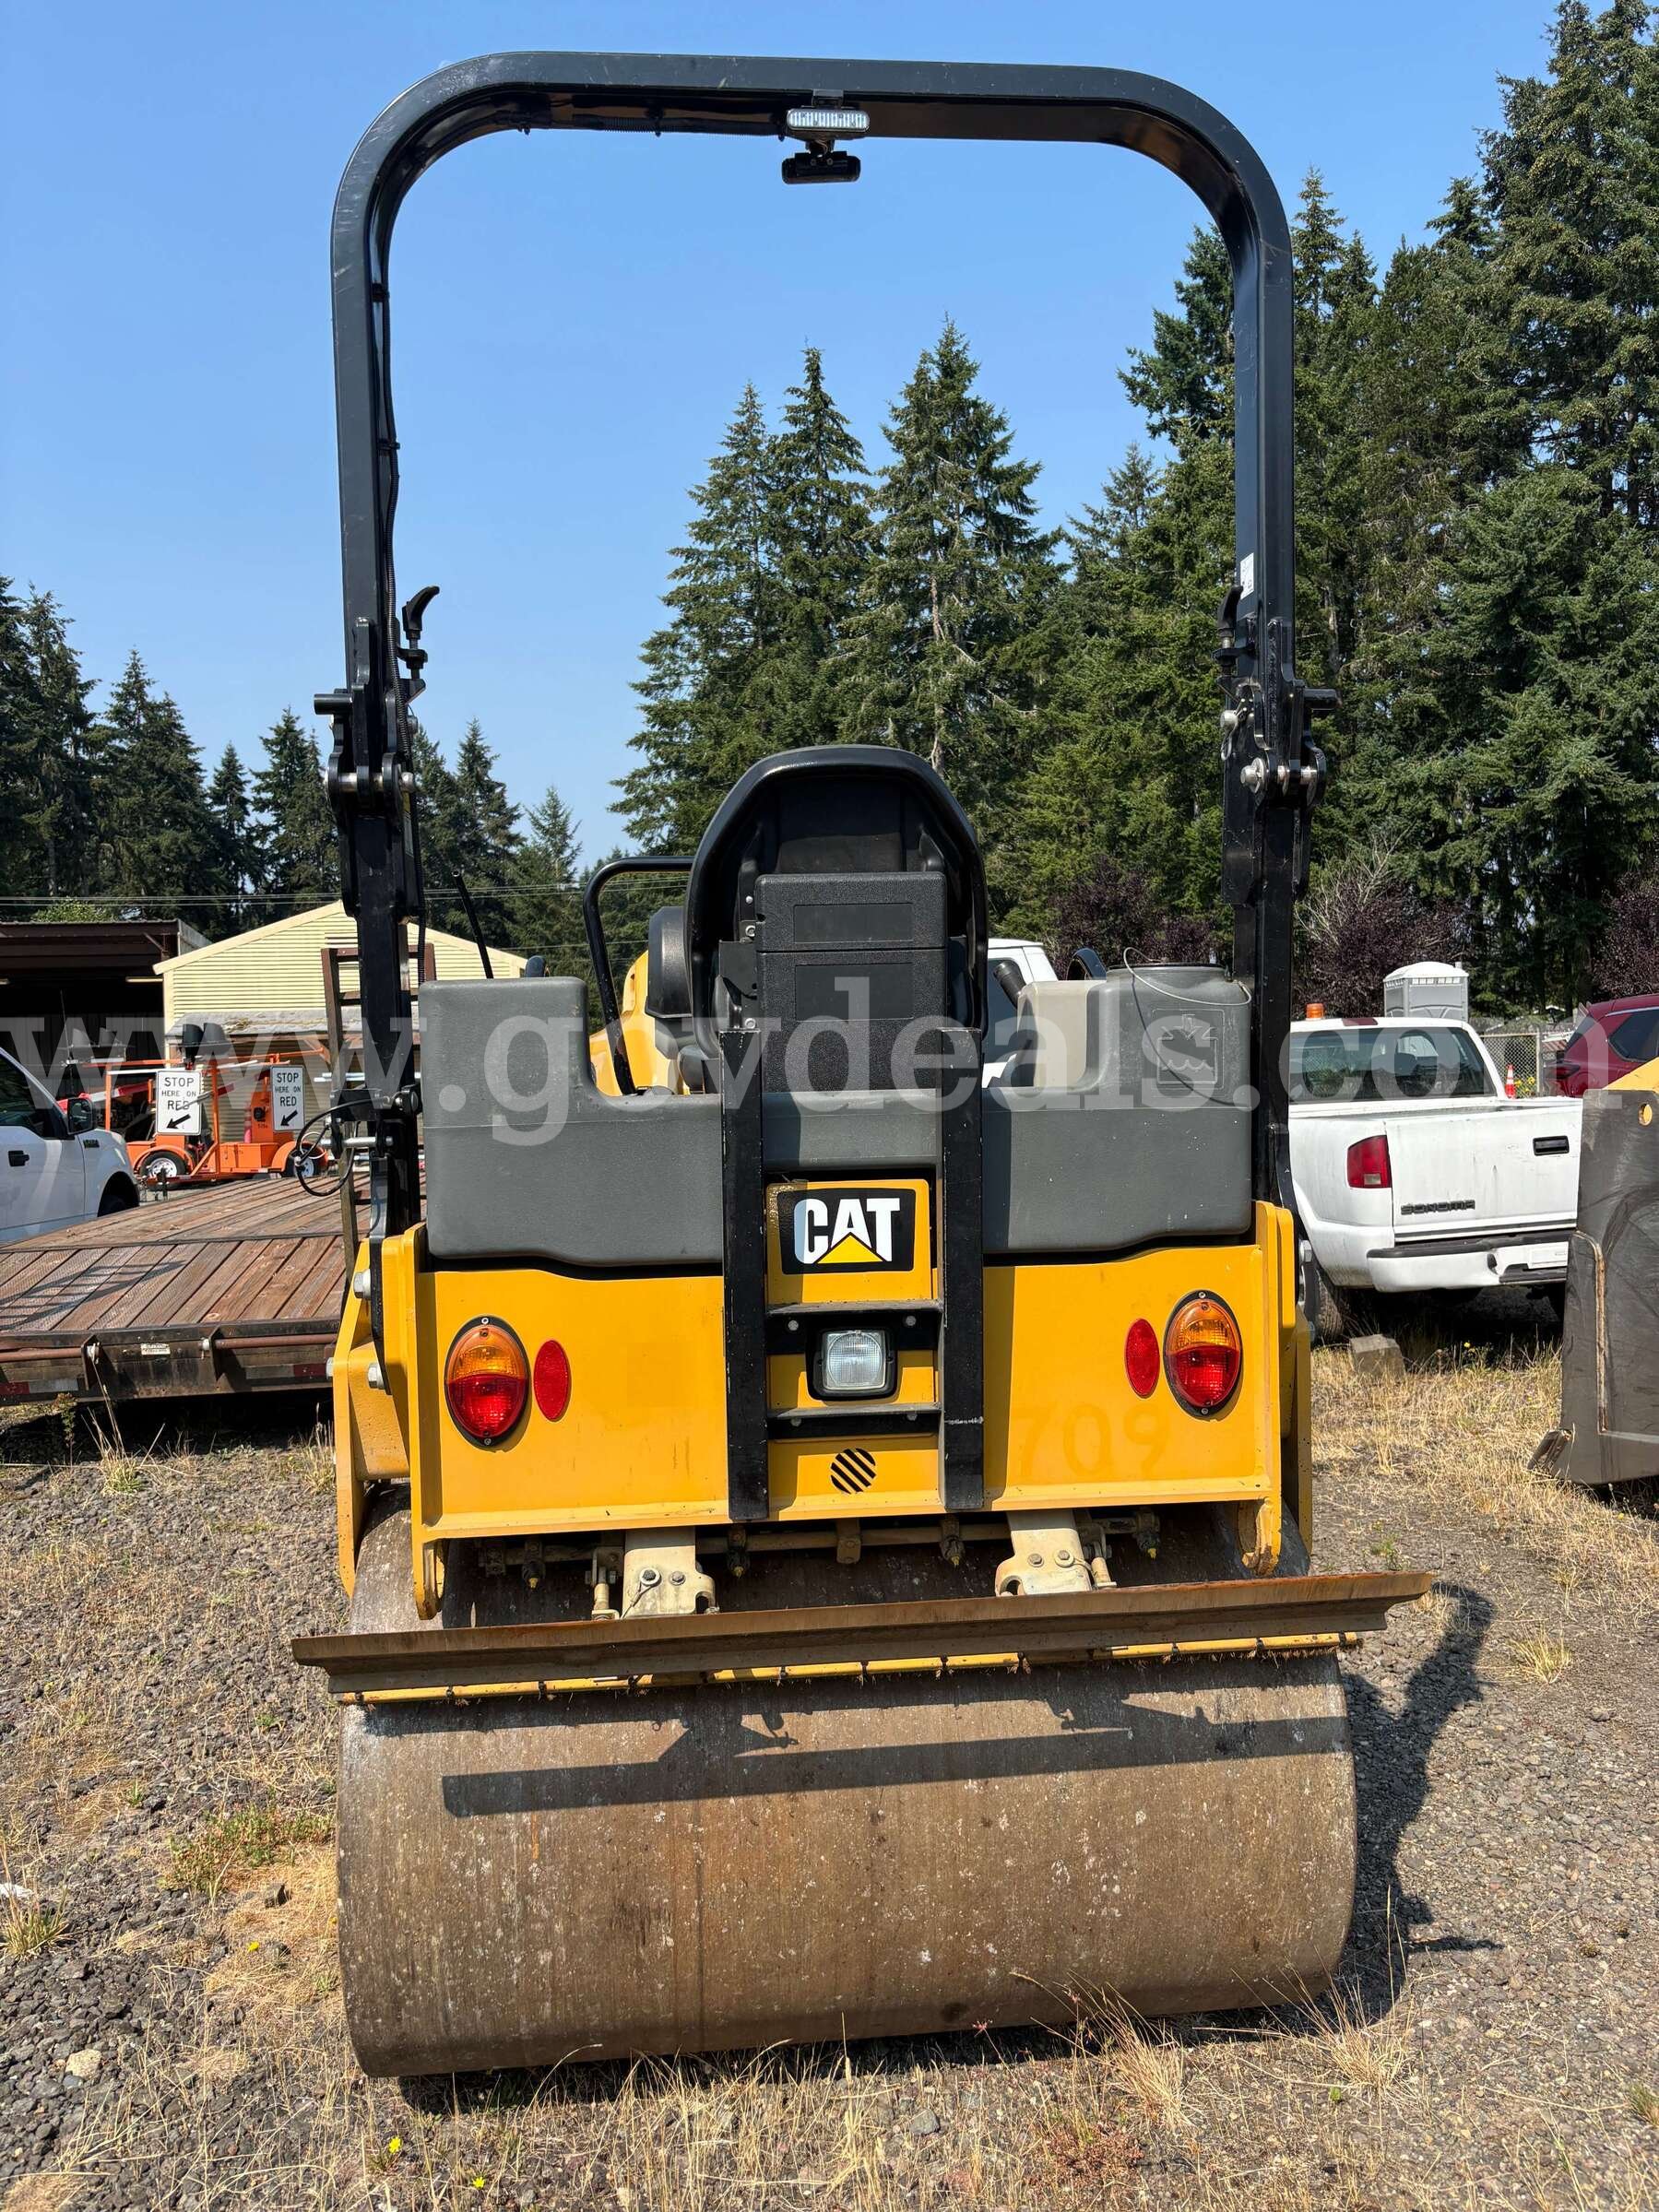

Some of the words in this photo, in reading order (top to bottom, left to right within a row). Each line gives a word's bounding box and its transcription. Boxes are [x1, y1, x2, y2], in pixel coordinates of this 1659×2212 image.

[164, 1077, 195, 1087] STOP
[277, 1072, 299, 1083] STOP
[279, 1096, 297, 1106] RED
[1401, 1200, 1475, 1215] SONOMA
[794, 1198, 900, 1264] CAT
